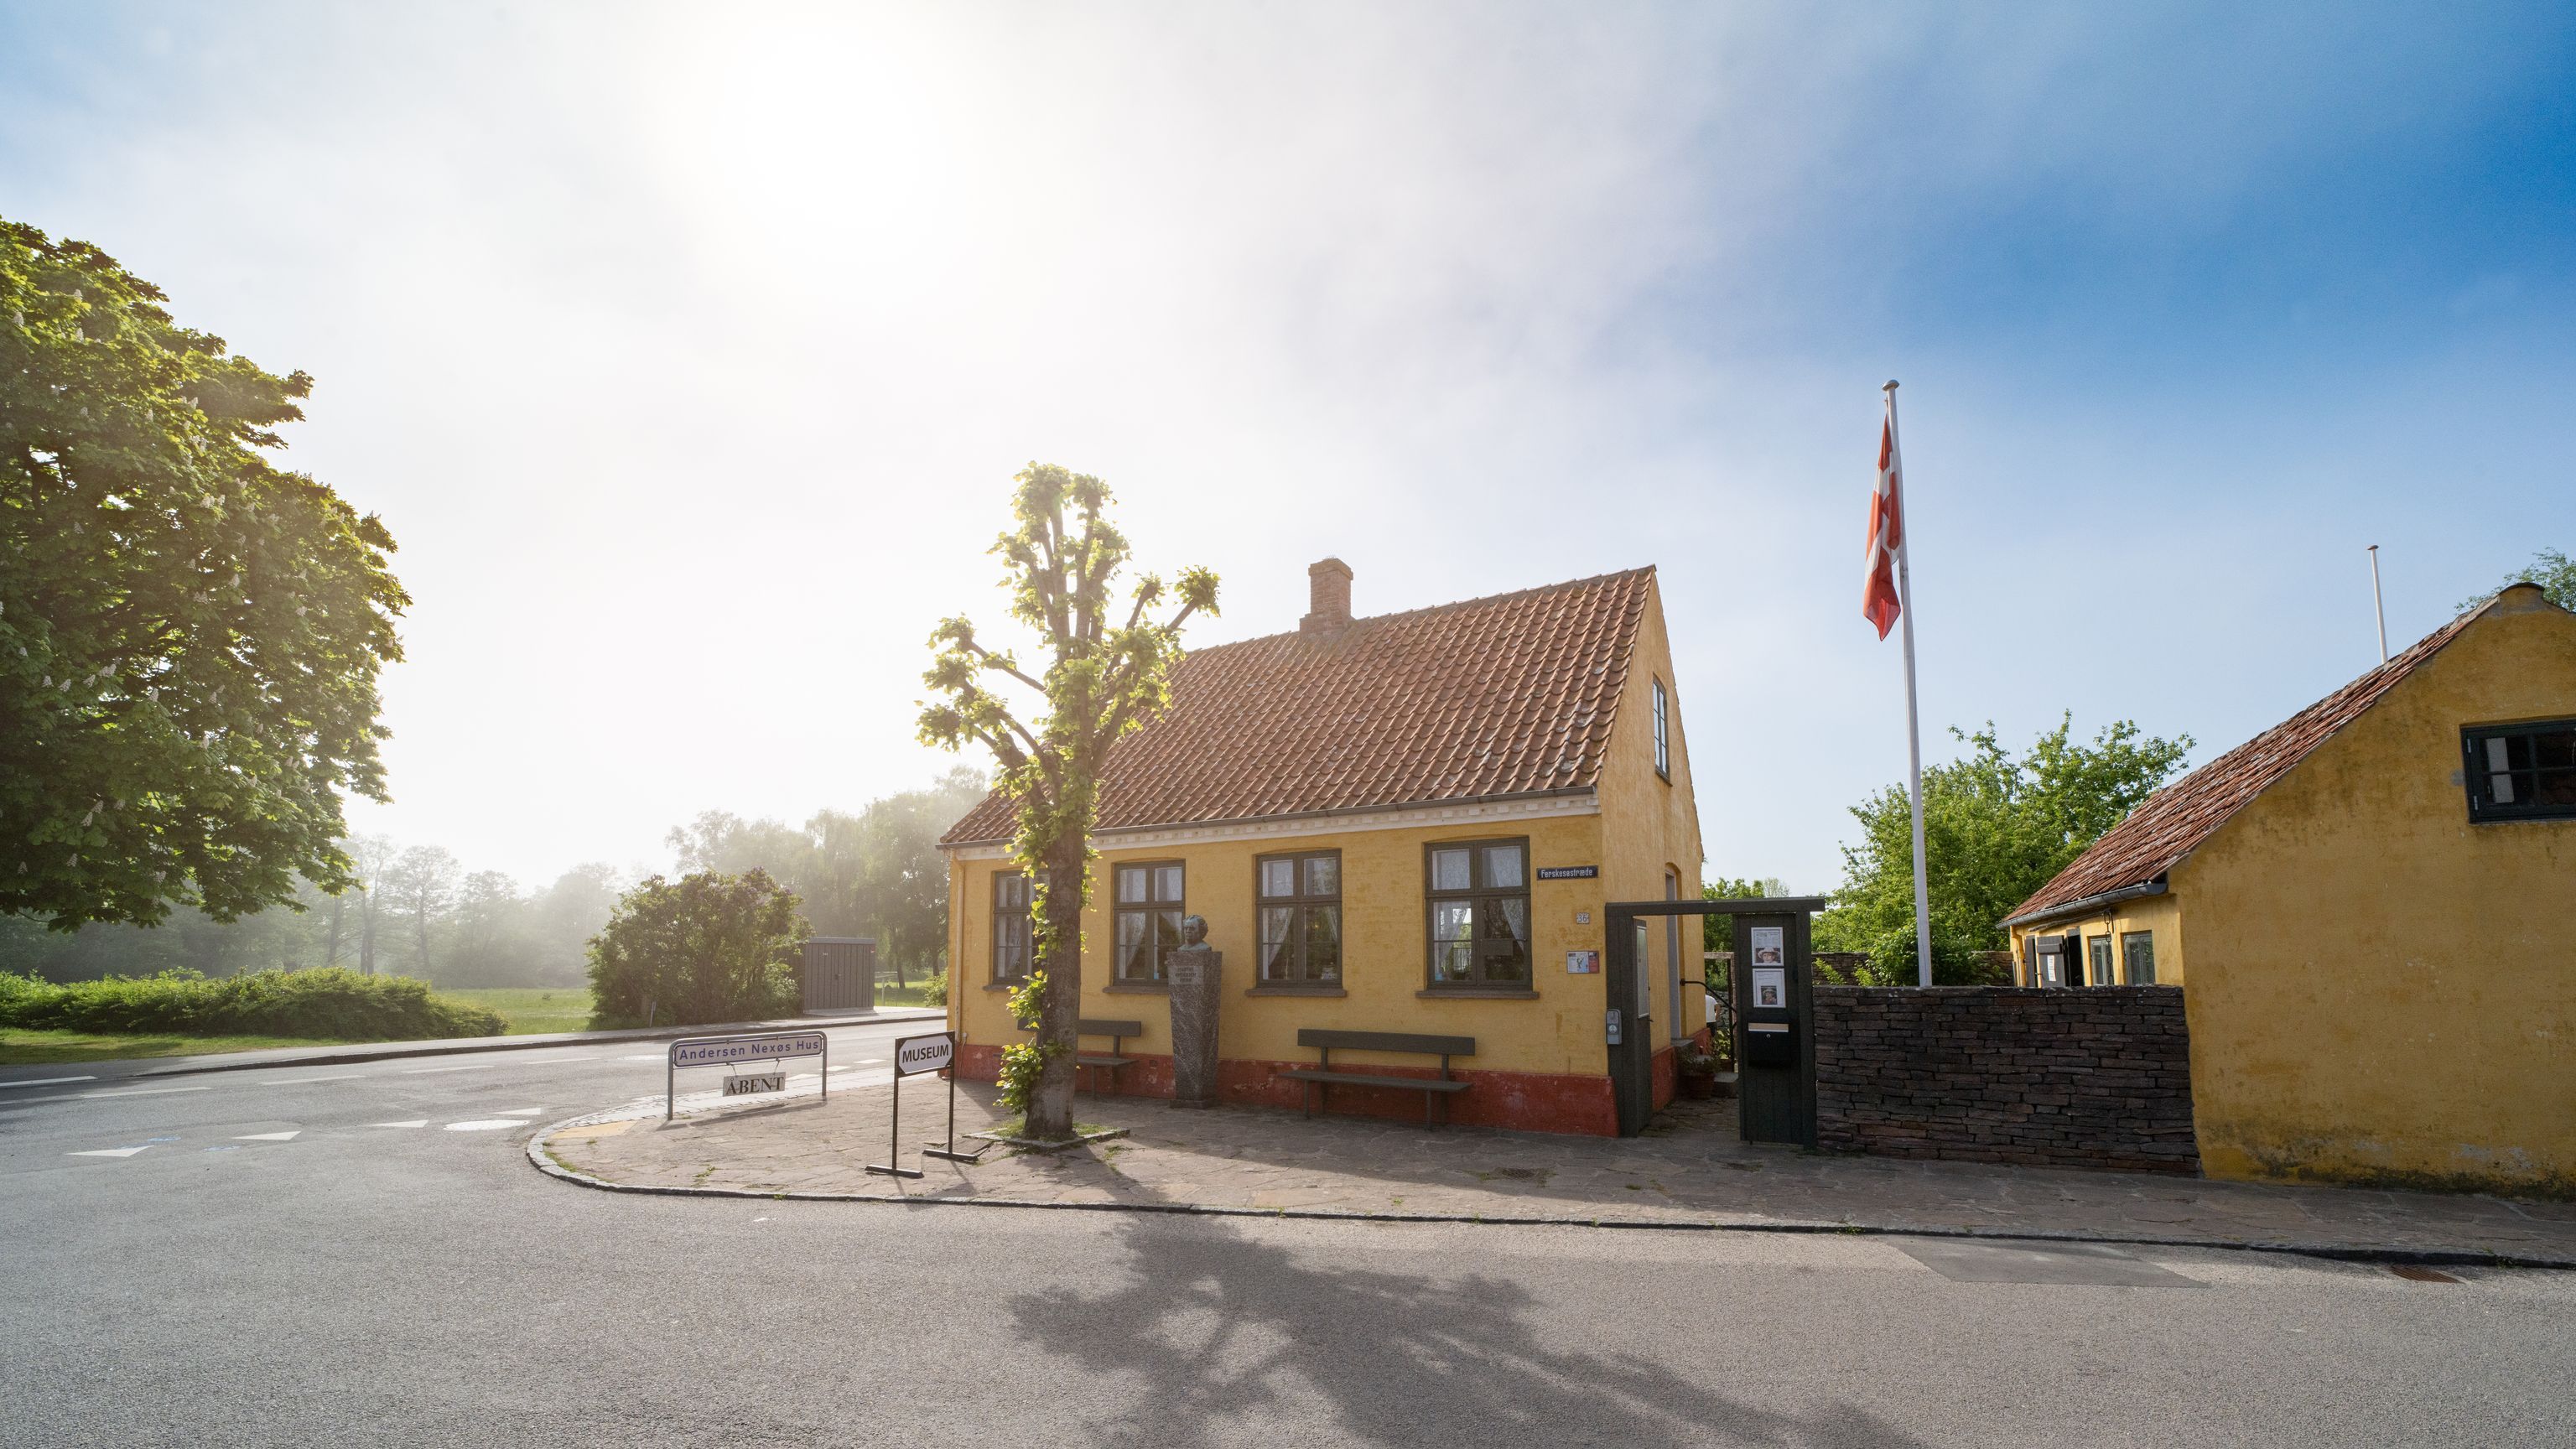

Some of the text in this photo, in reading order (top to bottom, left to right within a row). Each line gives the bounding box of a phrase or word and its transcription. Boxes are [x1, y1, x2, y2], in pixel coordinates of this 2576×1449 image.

[679, 1040, 818, 1061] Andersen Nexøs Hus
[902, 1044, 949, 1063] MUSEUM
[725, 1077, 784, 1096] ÅBENT
